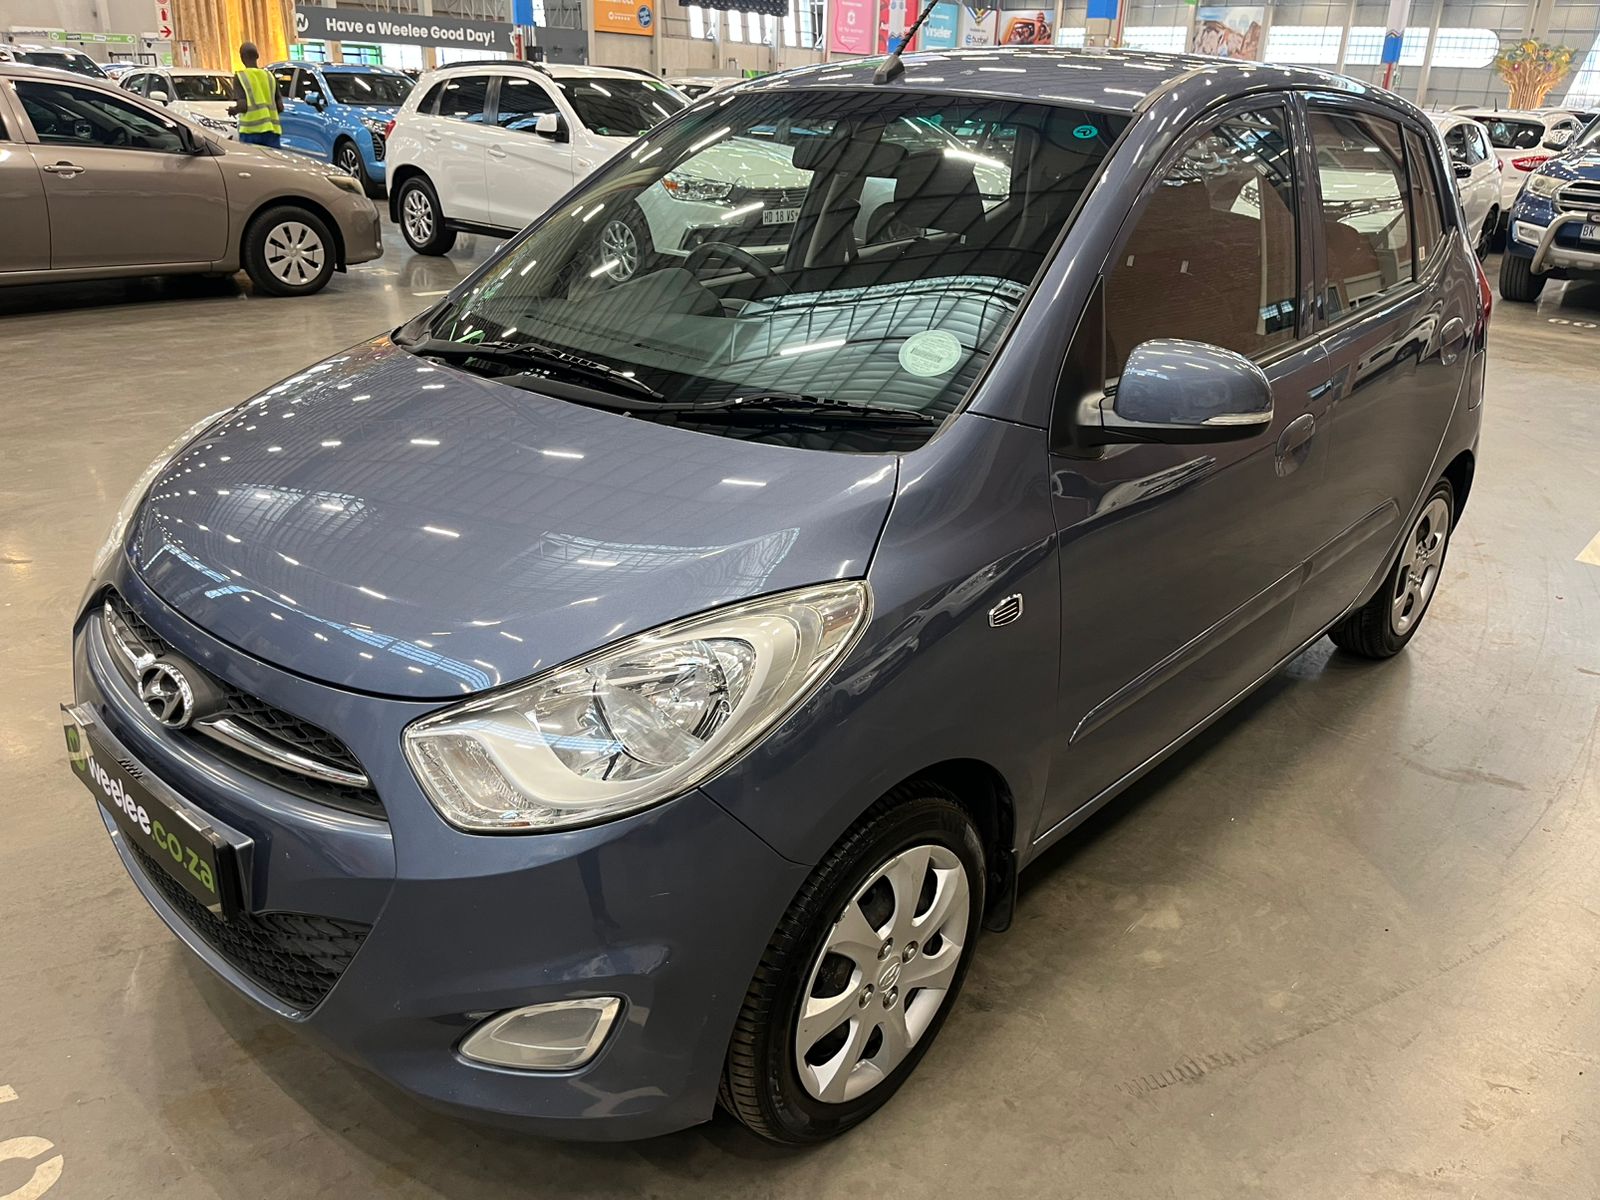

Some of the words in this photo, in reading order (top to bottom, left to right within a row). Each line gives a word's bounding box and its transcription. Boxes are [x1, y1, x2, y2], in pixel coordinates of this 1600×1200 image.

[326, 17, 364, 34] Have
[366, 24, 376, 35] a
[378, 21, 429, 37] Weelee
[430, 25, 464, 41] Good
[467, 28, 495, 46] Day!
[776, 211, 784, 222] 18
[1582, 223, 1595, 237] BK
[87, 755, 215, 893] weelee.co.za
